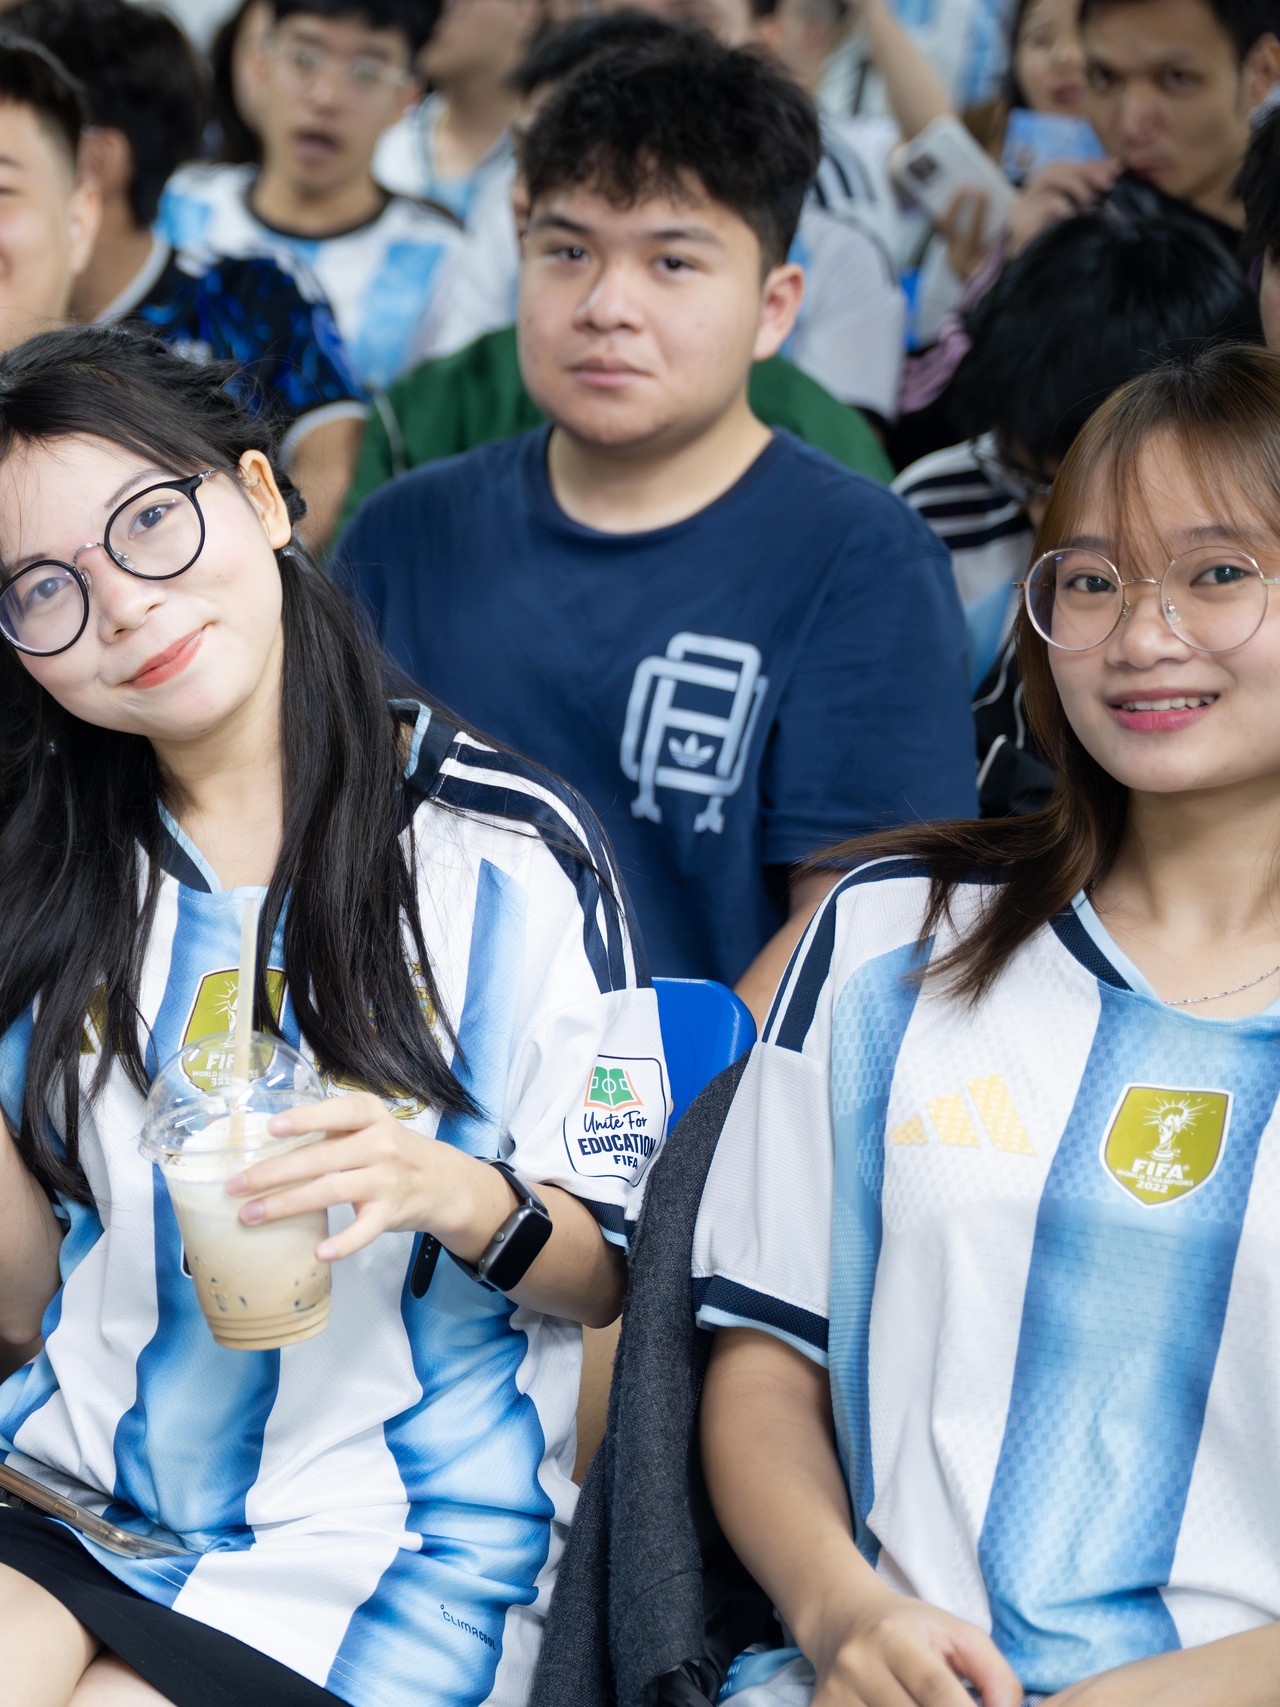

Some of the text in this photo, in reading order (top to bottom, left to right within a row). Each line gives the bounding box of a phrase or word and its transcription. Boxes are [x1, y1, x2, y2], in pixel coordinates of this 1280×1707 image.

[206, 1053, 235, 1070] FIF
[583, 1110, 648, 1135] Unite For
[577, 1133, 657, 1160] EDUCATION
[613, 1155, 638, 1170] FIFA
[1131, 1158, 1184, 1180] FIFA
[1135, 1179, 1169, 1194] 2022
